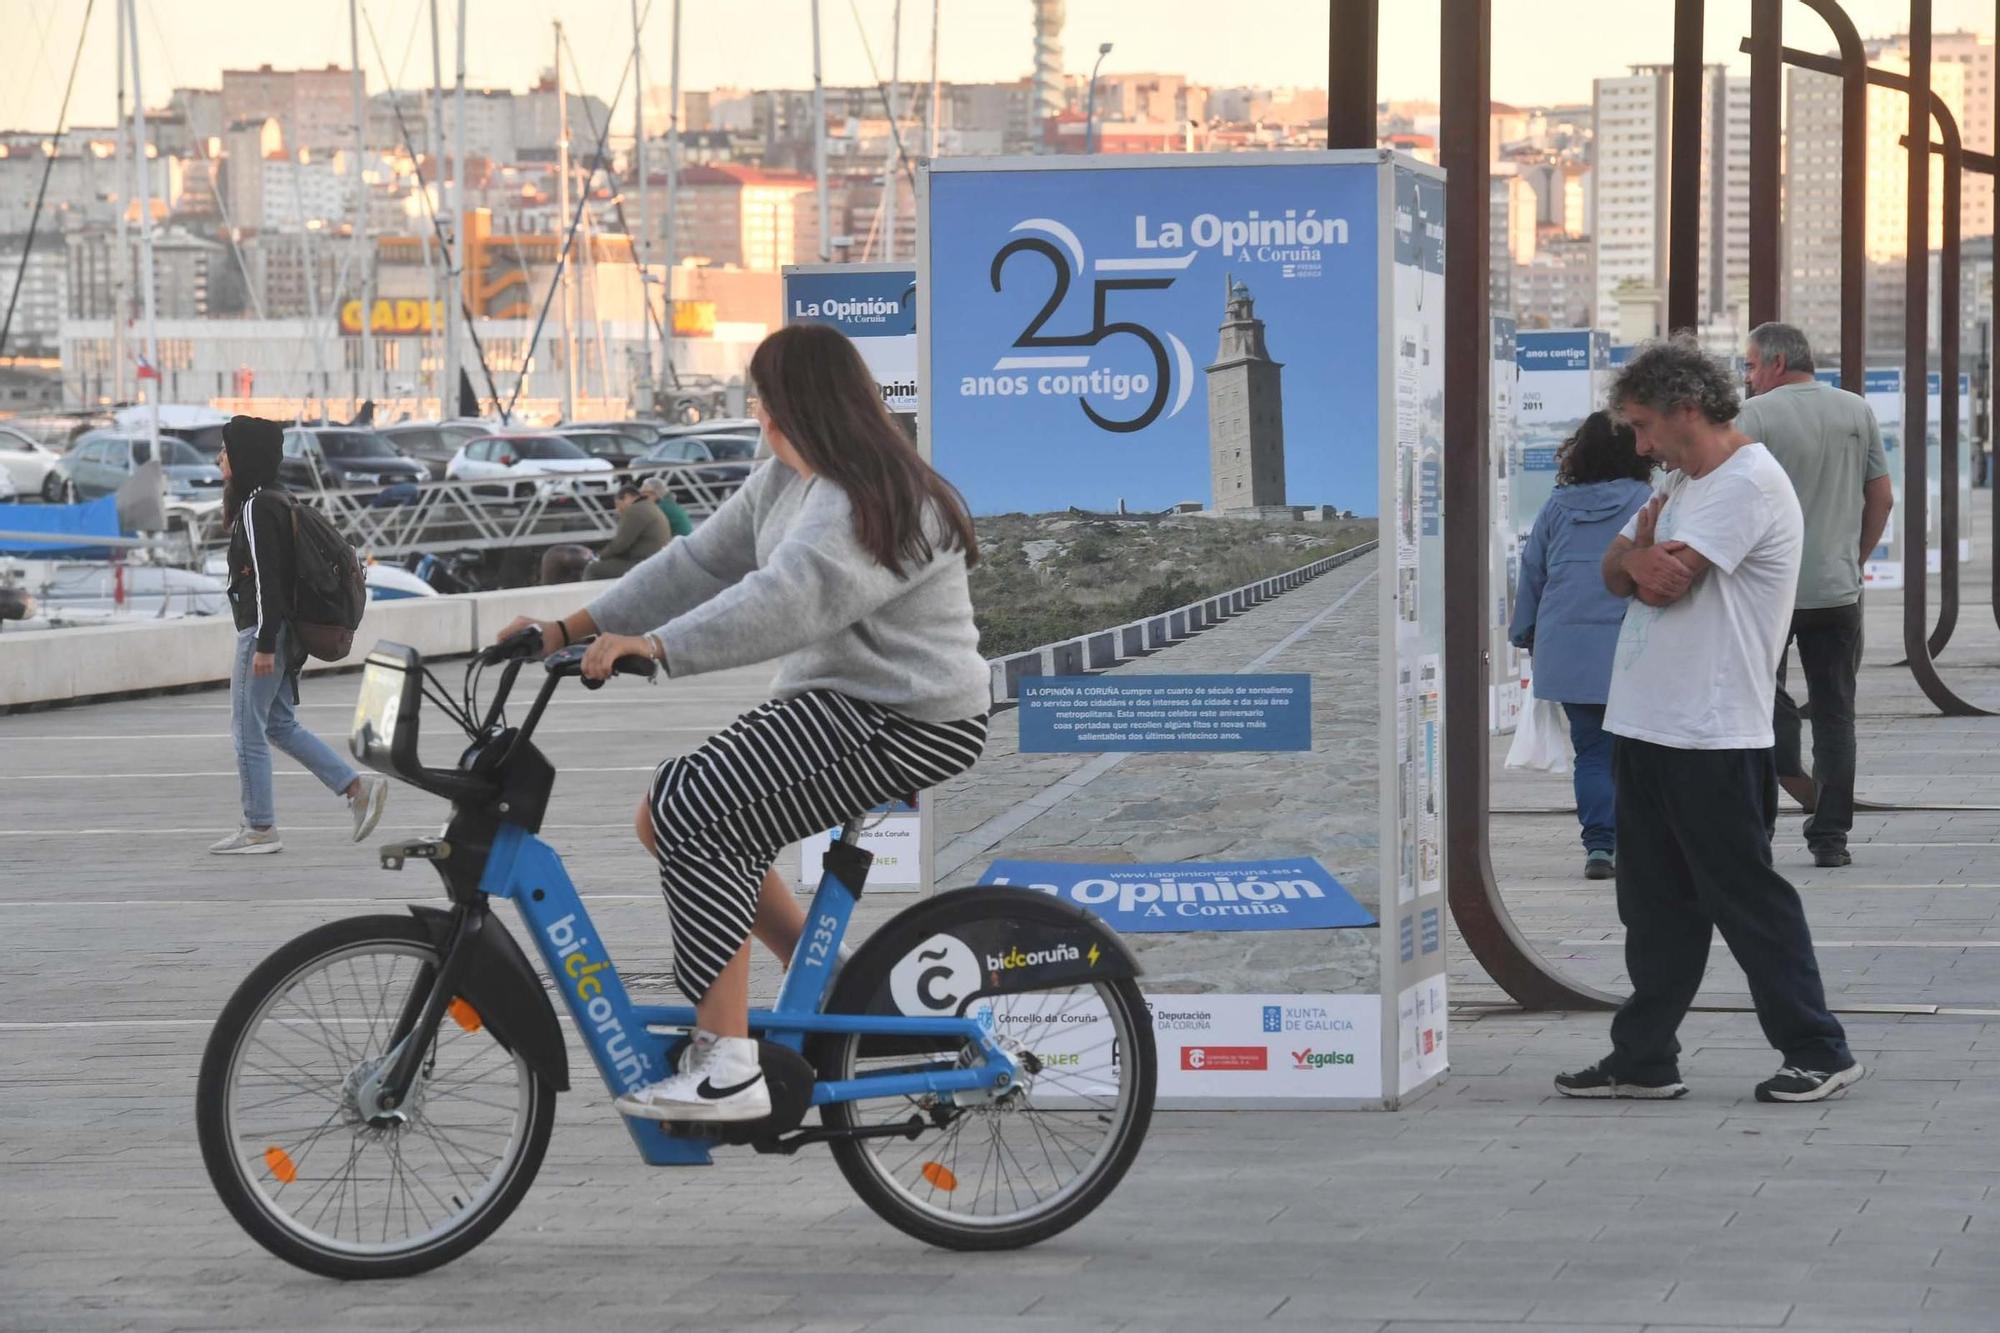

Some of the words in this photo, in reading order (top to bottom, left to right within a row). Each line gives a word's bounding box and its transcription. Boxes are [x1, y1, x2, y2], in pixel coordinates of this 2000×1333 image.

[1136, 215, 1183, 249] La
[1191, 210, 1349, 257] Opinión
[1238, 246, 1251, 261] A
[1257, 245, 1321, 262] Coruña
[795, 301, 819, 317] La
[822, 297, 899, 320] Opinión
[854, 315, 886, 323] Coruña
[990, 237, 1171, 433] 25
[1526, 350, 1548, 358] anos
[1549, 348, 1585, 359] contigo
[960, 374, 1028, 396] anos
[1037, 368, 1149, 400] contigo
[879, 381, 918, 401] pini
[1523, 402, 1543, 410] 2011
[1026, 688, 1037, 696] LA
[1039, 686, 1074, 696] OPINIÓN
[1075, 687, 1083, 696] A
[1084, 686, 1119, 696] CORUÑA
[1121, 688, 1152, 697] cumpre
[1166, 687, 1193, 695] cuarto
[1195, 686, 1206, 694] de
[1207, 686, 1234, 695] século
[1235, 686, 1247, 694] de
[1073, 699, 1088, 707] dos
[1135, 698, 1151, 706] dos
[1152, 698, 1190, 706] intereses
[1204, 697, 1232, 706] cidade
[1056, 710, 1115, 719] metropolitana.
[1117, 709, 1135, 718] Esta
[1137, 709, 1166, 718] mostra
[1167, 708, 1198, 717] celebra
[1199, 709, 1217, 717] este
[1219, 708, 1265, 717] aniversario
[1053, 722, 1073, 730] coas
[1074, 720, 1111, 731] portadas
[1113, 721, 1128, 731] que
[1220, 720, 1245, 728] novas
[1129, 731, 1144, 740] dos
[1145, 730, 1176, 740] últimos
[1178, 730, 1219, 740] vintecinco
[883, 830, 910, 838] Coruña
[1071, 876, 1326, 911] Opinión
[1144, 904, 1166, 917] A
[1176, 901, 1289, 917] Coruña
[805, 914, 838, 967] 1235
[998, 1014, 1042, 1024] Concello
[1044, 1014, 1058, 1024] da
[1060, 1013, 1098, 1024] Coruña
[1158, 1011, 1211, 1023] Deputación
[1286, 1008, 1327, 1019] XUNTA
[1158, 1021, 1171, 1030] DA
[1172, 1021, 1211, 1031] CORUÑA
[1286, 1020, 1303, 1031] DE
[1304, 1019, 1354, 1031] GALICIA
[1291, 1048, 1355, 1068] Vegalsa
